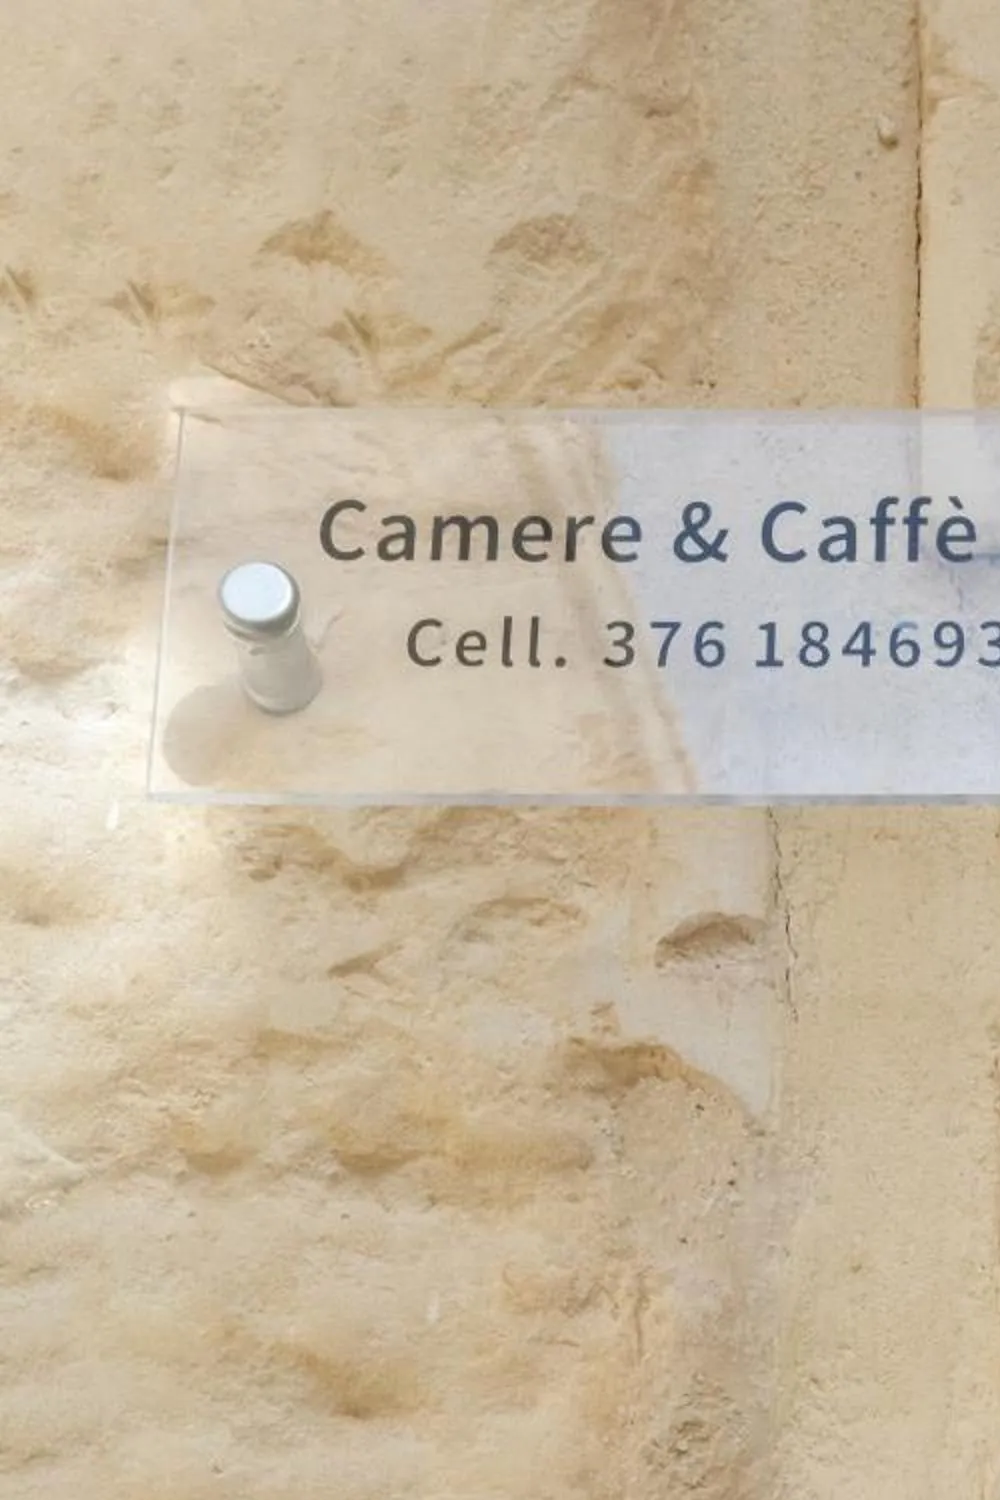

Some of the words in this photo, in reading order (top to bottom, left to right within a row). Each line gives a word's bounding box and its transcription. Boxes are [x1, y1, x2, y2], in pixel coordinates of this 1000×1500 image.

[320, 499, 642, 563] Camere
[673, 501, 728, 563] &
[761, 496, 976, 563] Caffè
[407, 616, 566, 668] Cell.
[603, 621, 725, 668] 376
